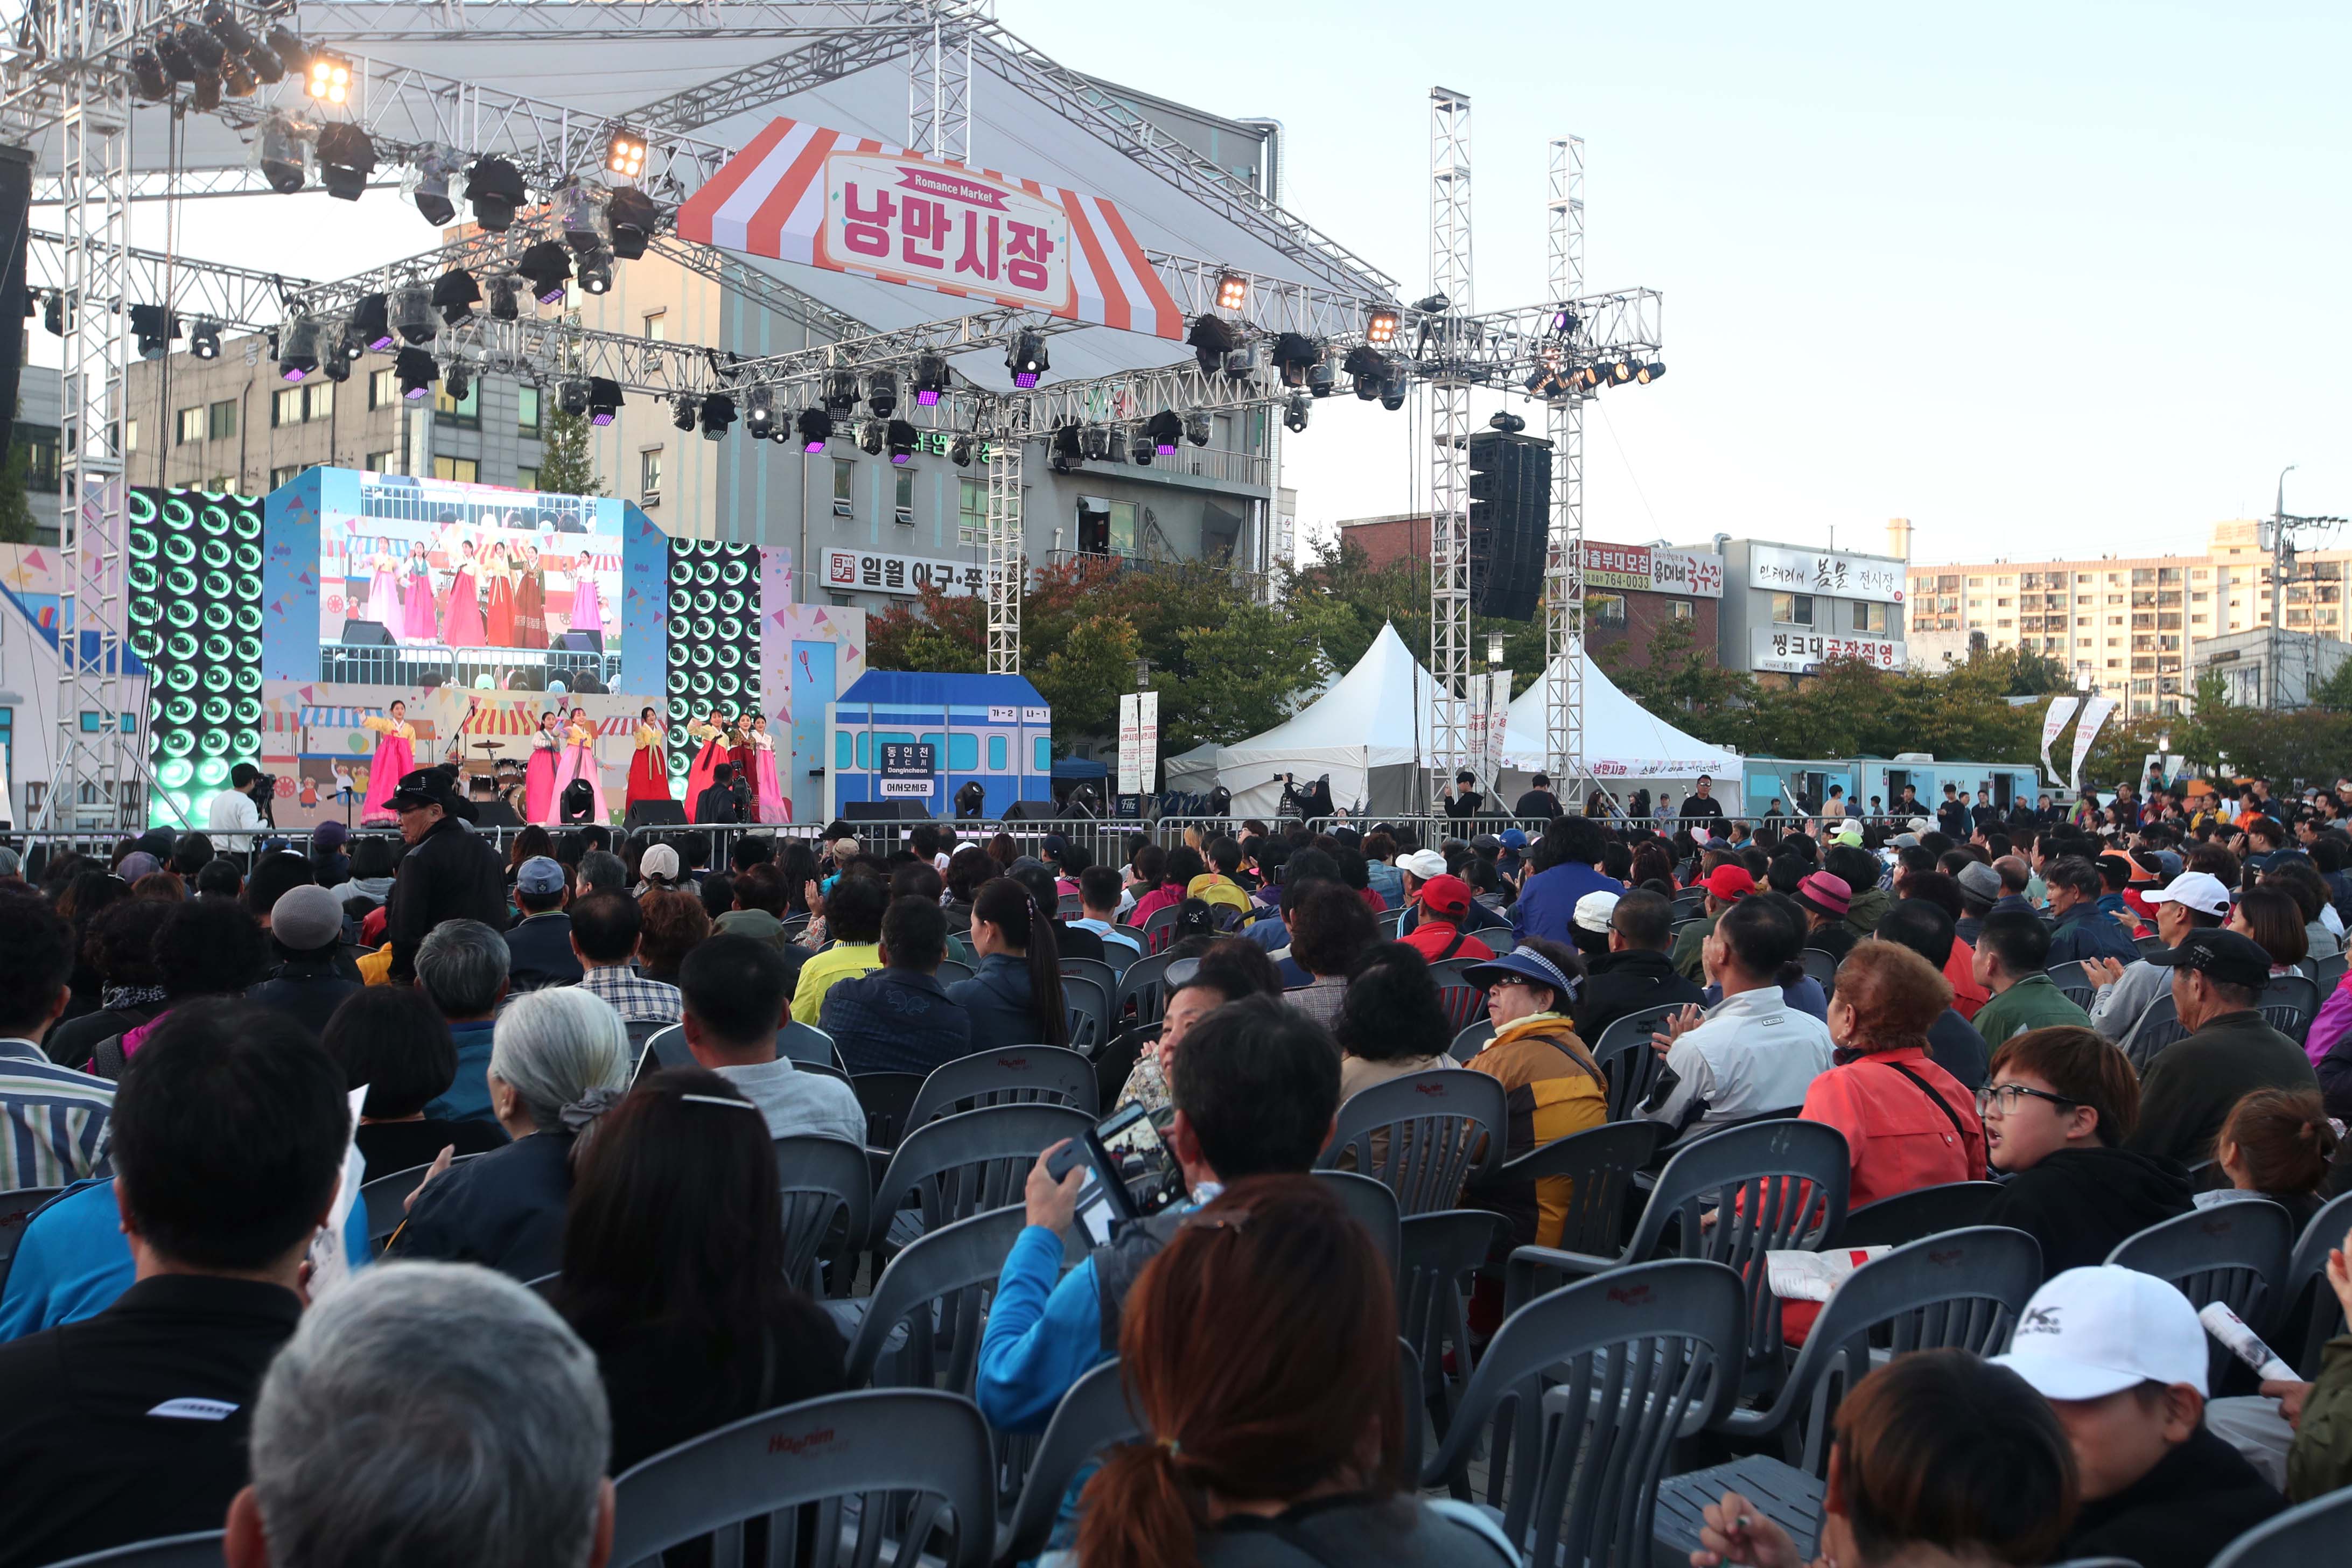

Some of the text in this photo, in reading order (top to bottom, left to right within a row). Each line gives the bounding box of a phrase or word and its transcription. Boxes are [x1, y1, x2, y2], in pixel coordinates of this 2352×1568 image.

[914, 174, 993, 204] Romance Market
[844, 181, 1054, 292] 낭만시장
[862, 557, 904, 588] 일월
[1654, 556, 1721, 593] 용대네 국수집
[1605, 573, 1649, 589] 764-0033
[1859, 570, 1894, 593] 전시장
[887, 746, 928, 758] 동인천
[887, 767, 928, 775] Dongincheon
[1593, 762, 1627, 775] 낭만시장
[887, 783, 928, 792] 어서오세요
[1121, 797, 1136, 810] Fitz
